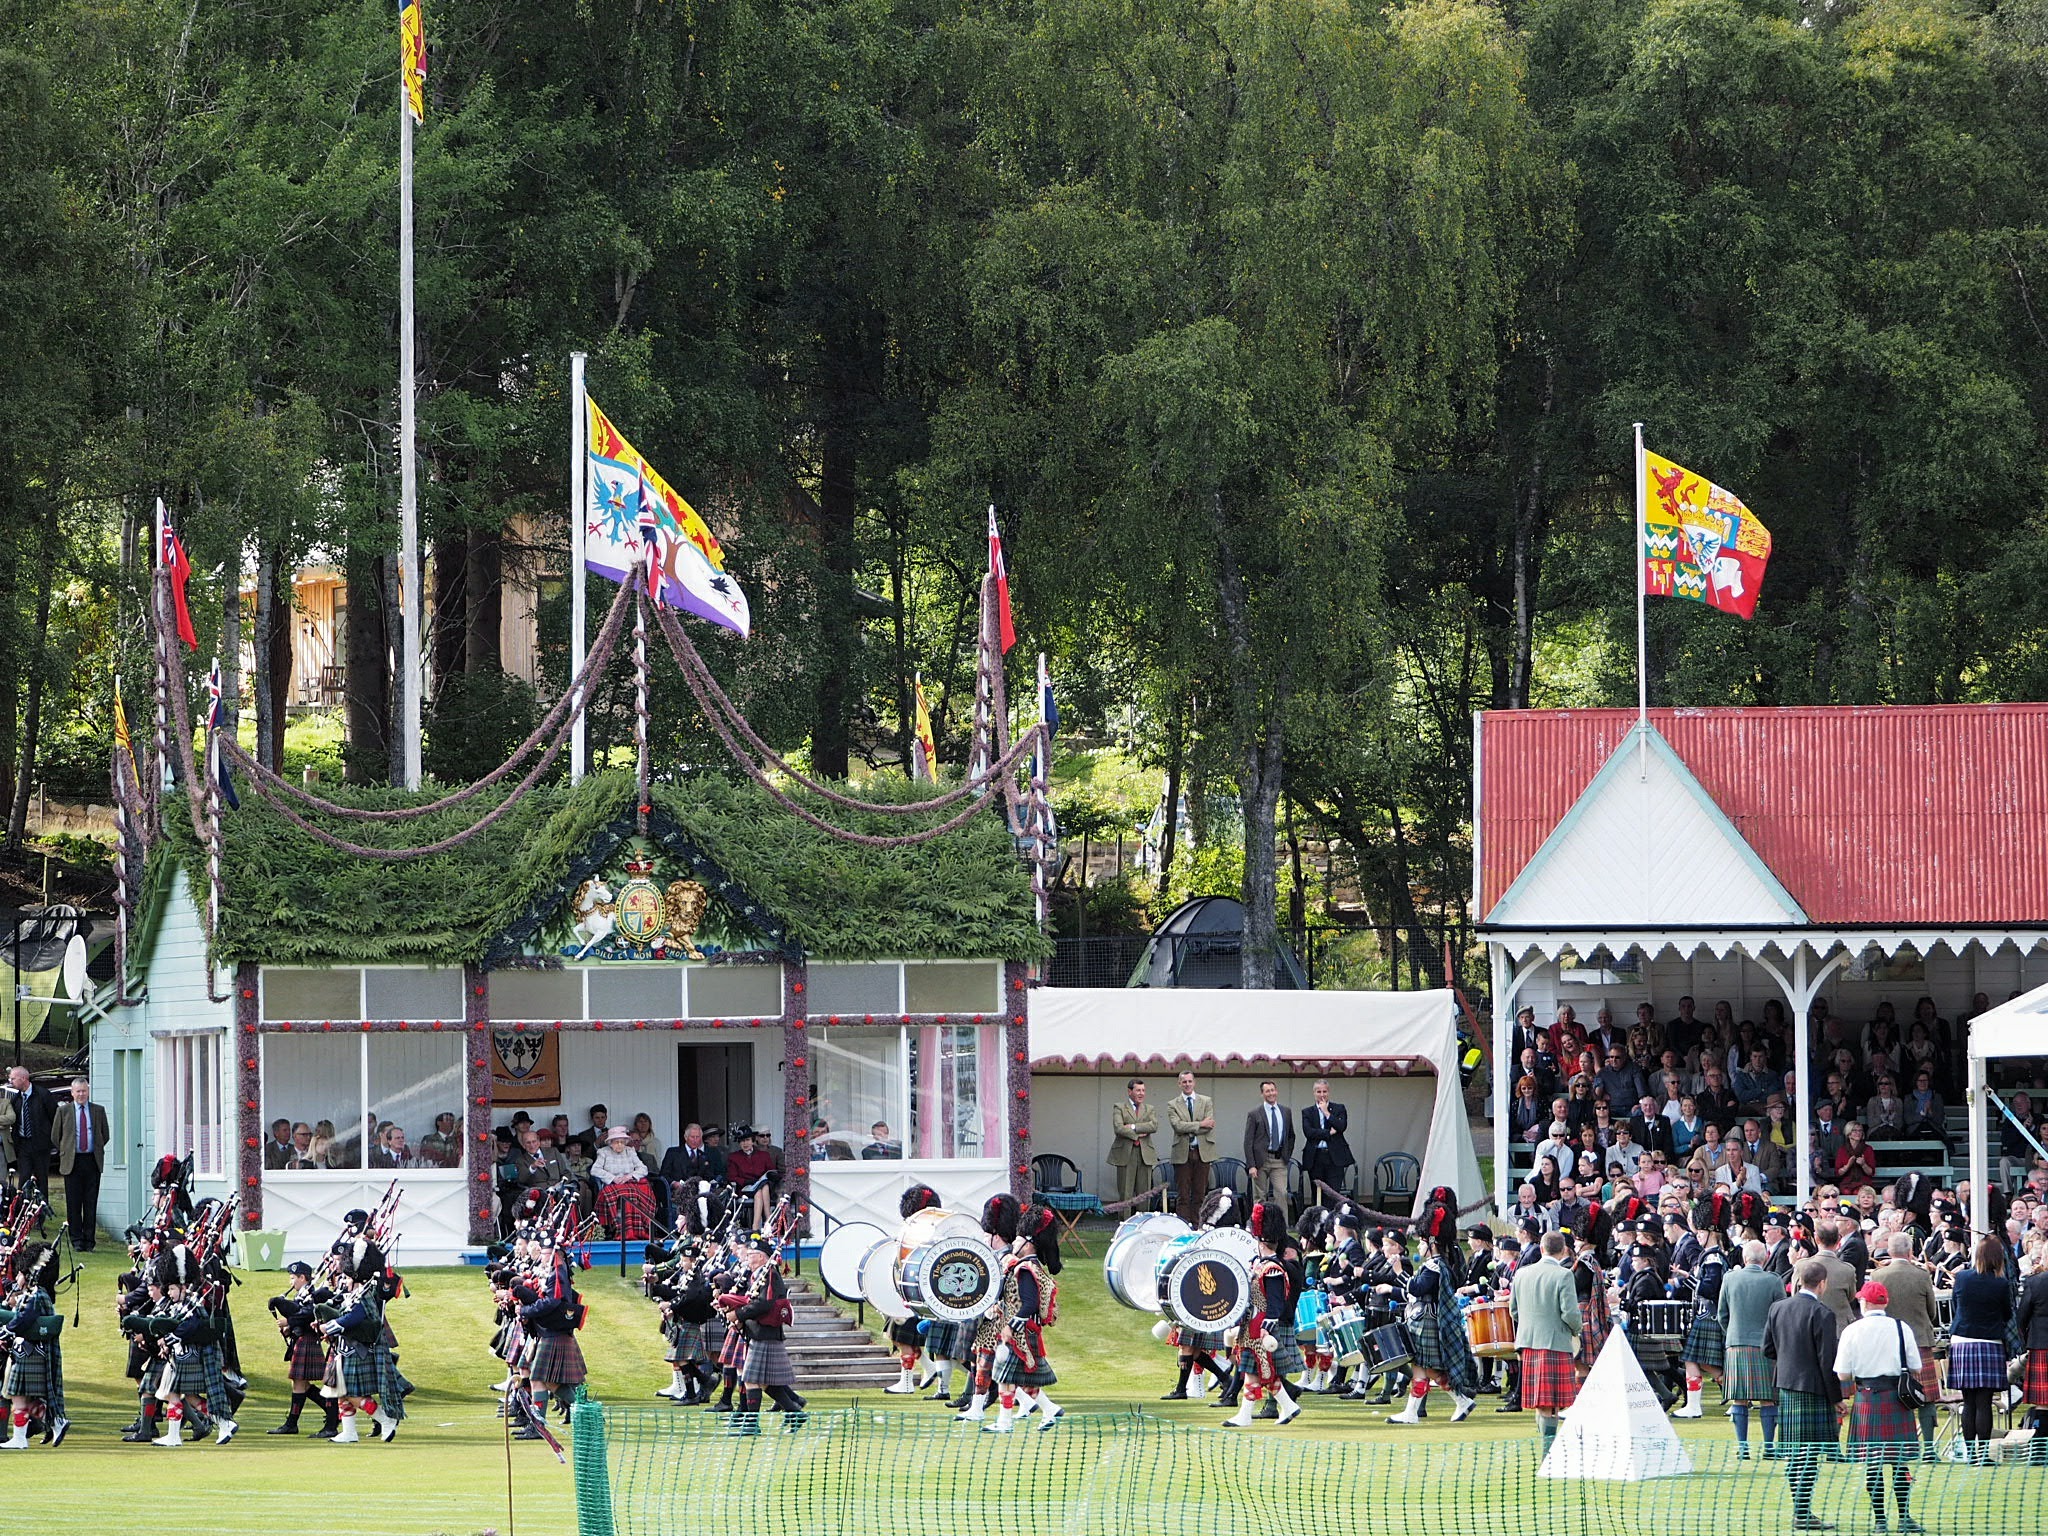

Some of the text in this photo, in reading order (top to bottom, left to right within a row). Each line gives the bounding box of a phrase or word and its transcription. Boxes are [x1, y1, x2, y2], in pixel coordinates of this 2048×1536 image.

[618, 950, 628, 960] ET
[633, 951, 652, 960] MON
[1230, 1229, 1252, 1245] Pipe
[945, 1241, 978, 1251] DISTRICT
[933, 1264, 942, 1279] The
[972, 1256, 987, 1277] Hotel
[1625, 1381, 1651, 1393] DANCING
